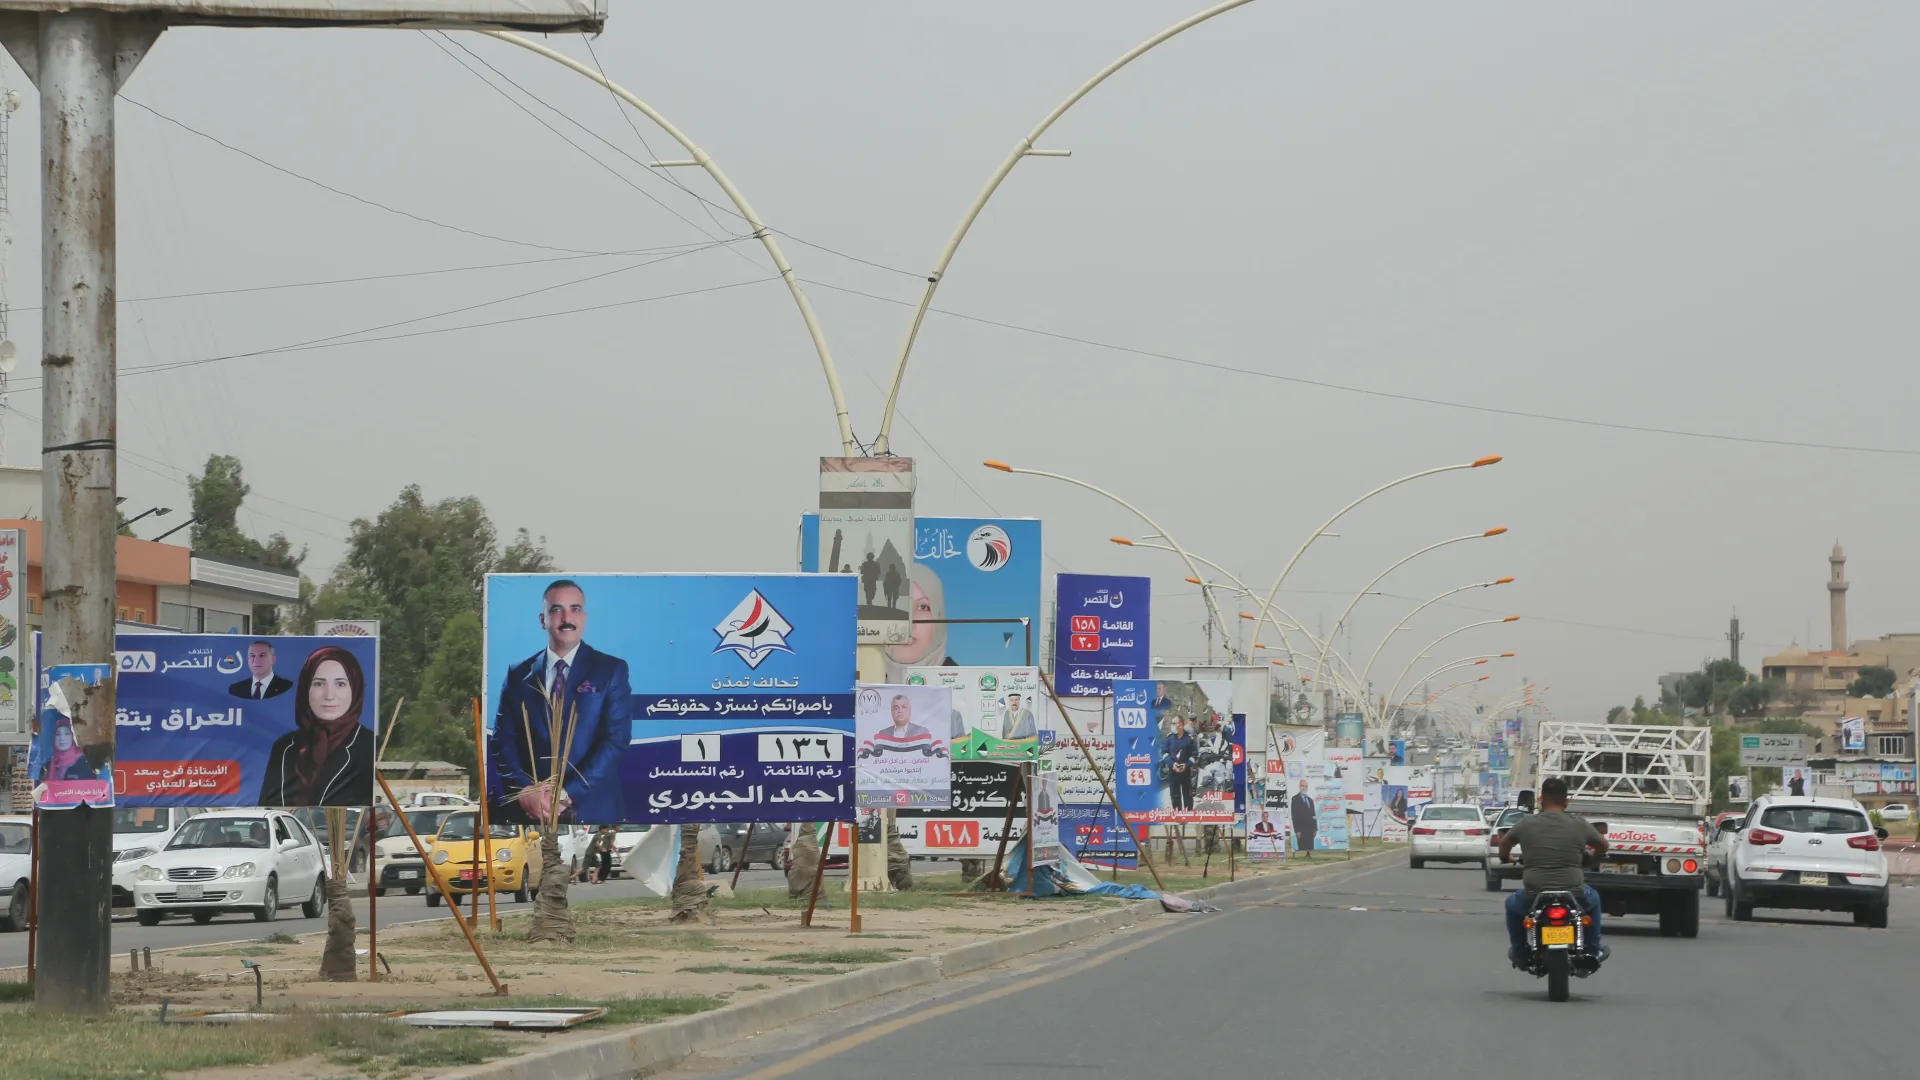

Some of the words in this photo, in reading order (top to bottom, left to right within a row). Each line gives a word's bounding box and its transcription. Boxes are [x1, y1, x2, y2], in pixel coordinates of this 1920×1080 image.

[1083, 593, 1108, 607] النصر
[1074, 618, 1096, 631] ١٥٨
[1102, 620, 1133, 631] القائمة
[1078, 637, 1092, 648] ٣٠
[1102, 638, 1134, 648] تسلسل
[121, 653, 151, 670] ٥٨
[160, 655, 213, 673] النصر
[1070, 670, 1092, 680] حقك
[1093, 670, 1133, 681] لاستعادة
[752, 676, 799, 689] تحالف
[1070, 686, 1098, 696] صوتك
[1115, 691, 1136, 704] النصر
[646, 697, 711, 716] حقوقكم
[713, 698, 759, 716] نسترد
[760, 696, 834, 716] بأصواتكم
[115, 708, 152, 731] يتق
[161, 707, 243, 731] العراق
[1120, 709, 1144, 726] ١٥٨
[775, 736, 832, 760] ١٣٦
[1764, 737, 1794, 747] الشلالات
[698, 738, 706, 761] ١
[1124, 753, 1152, 767] تسلسل
[133, 768, 158, 777] سعد
[160, 766, 184, 778] فرح
[187, 765, 228, 777] الأستاذة
[648, 765, 717, 780] التسلسل
[719, 767, 745, 780] رقم
[762, 764, 815, 778] القائمة
[816, 767, 843, 779] رقم
[1130, 770, 1145, 784] ٤٩
[146, 778, 187, 791] العبادي
[189, 776, 217, 788] نشاط
[957, 771, 1007, 785] تدريسية
[648, 785, 763, 814] الجبوري
[770, 785, 844, 804] احمد
[1201, 791, 1223, 804] اللواء
[1194, 808, 1215, 820] محمود
[1214, 808, 1233, 817] محمد
[932, 823, 972, 845] ١٦٨
[1608, 830, 1657, 842] MOTORS
